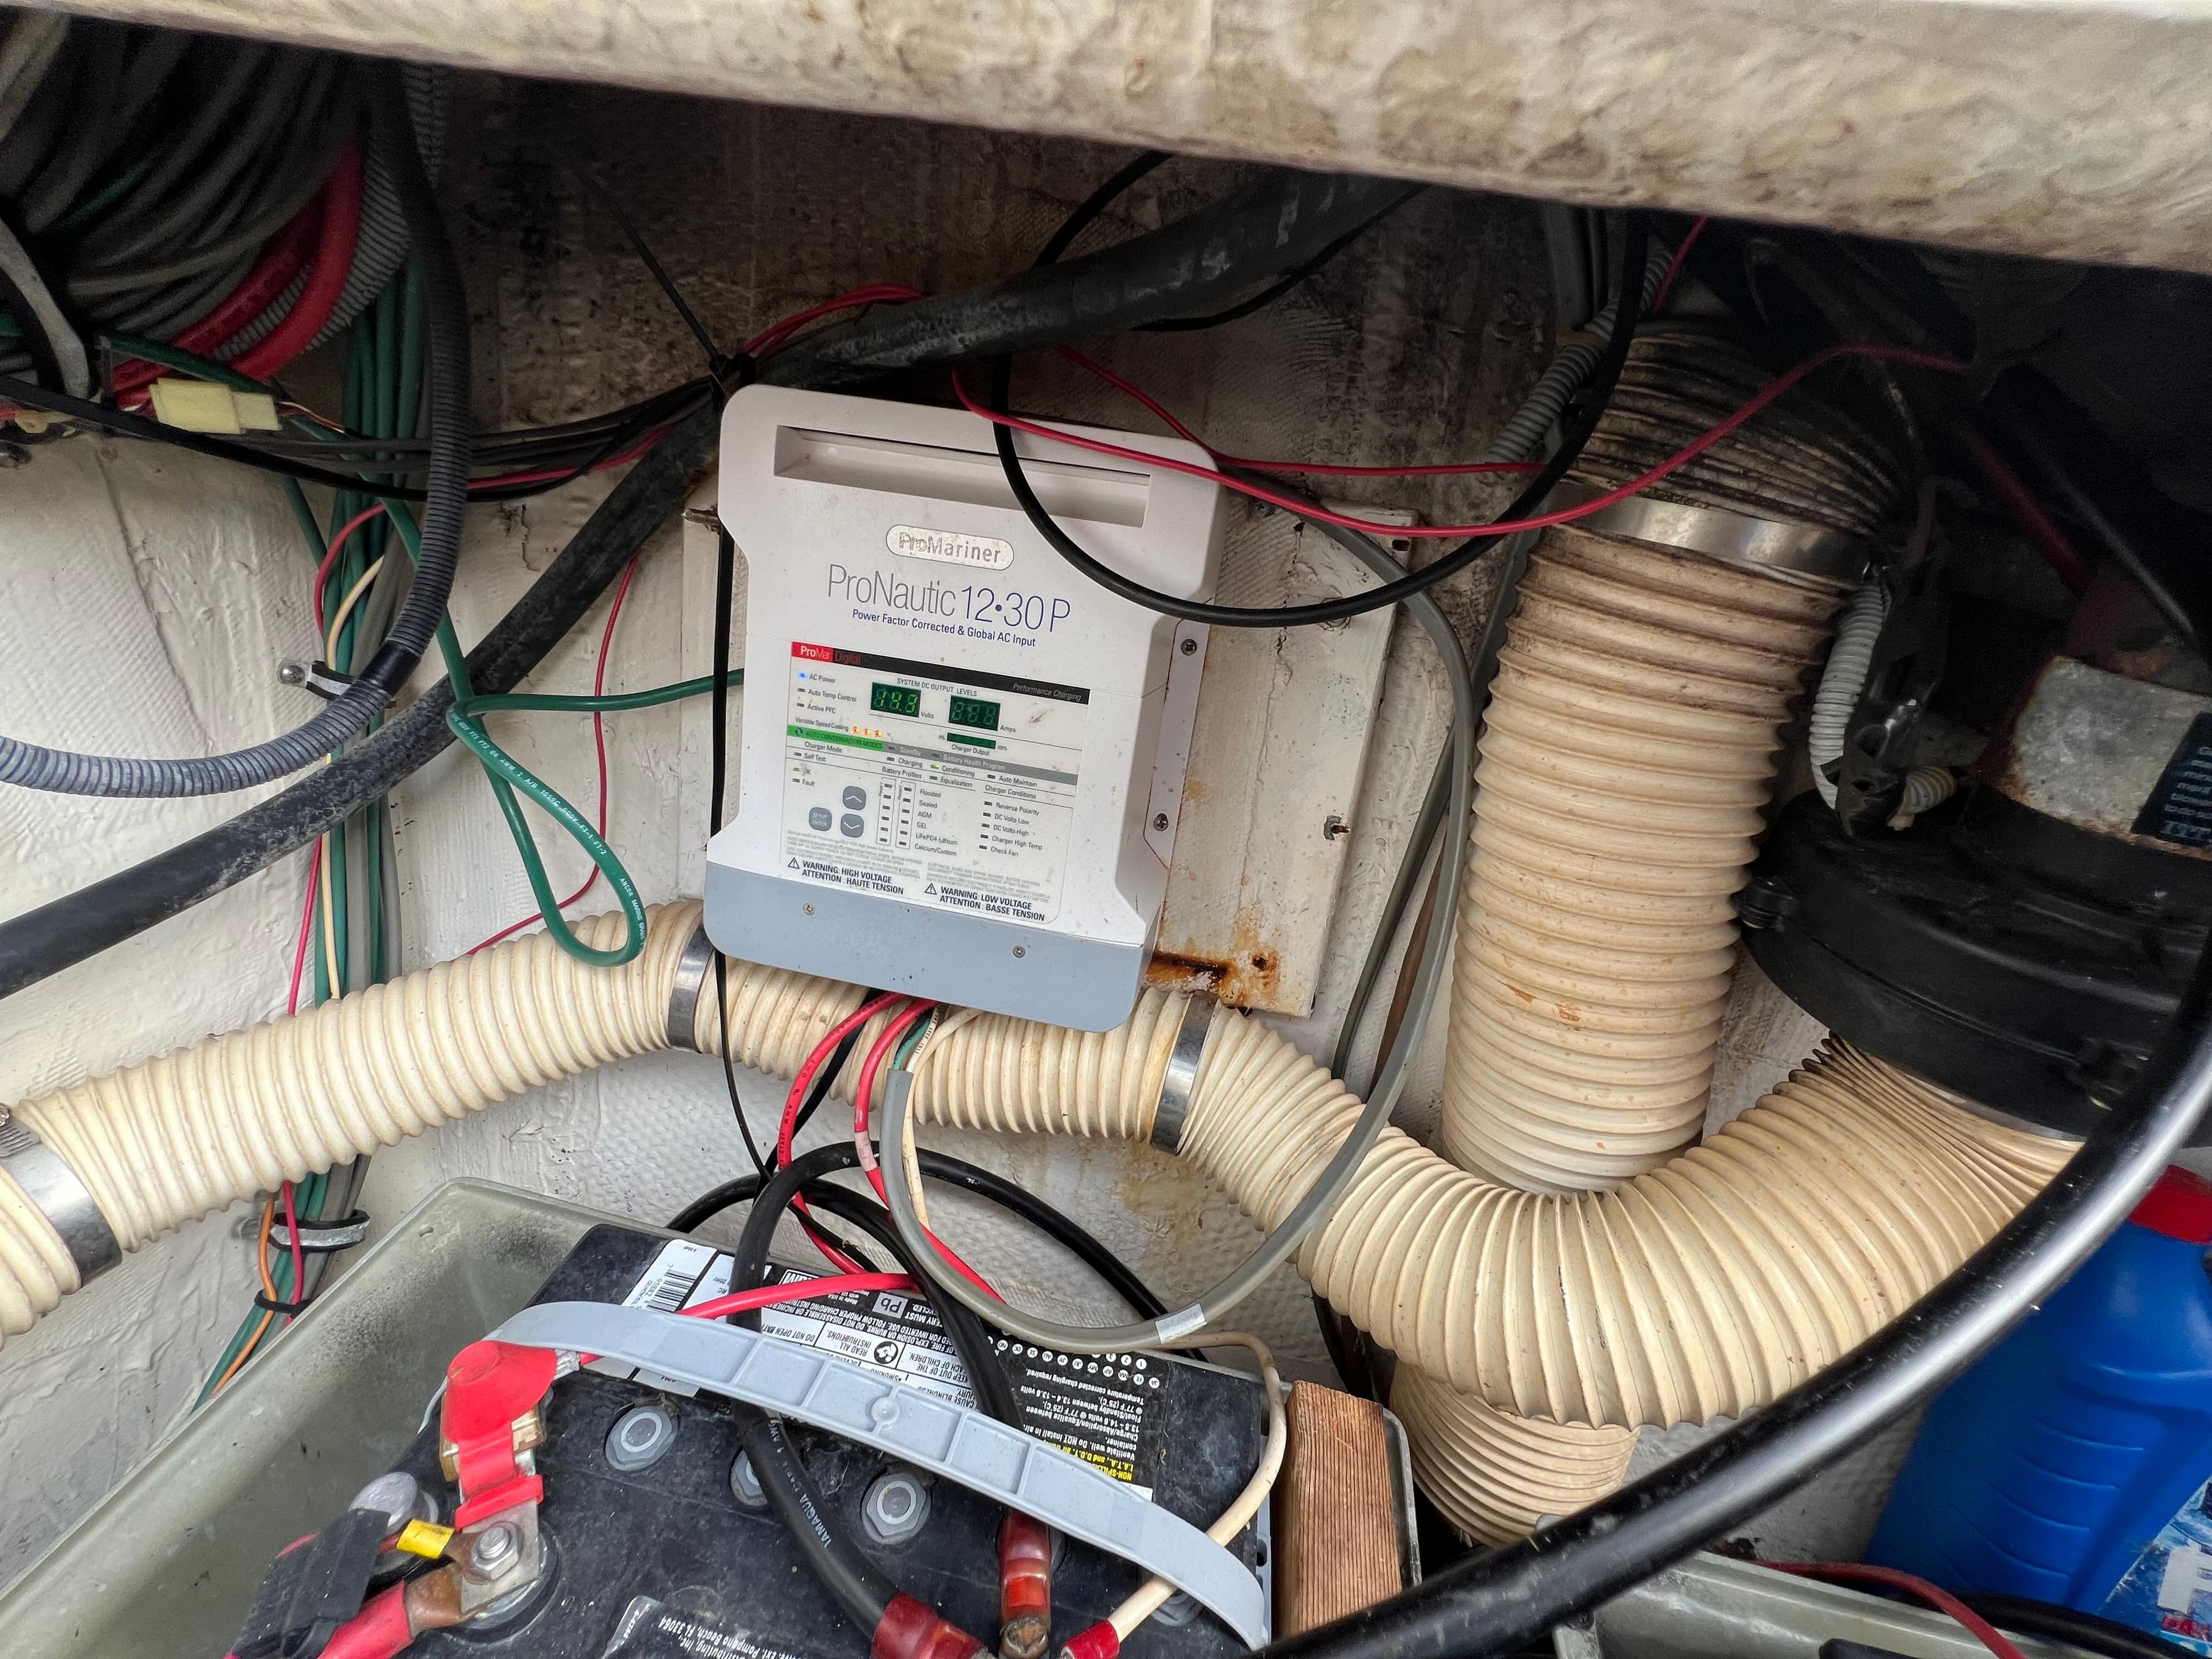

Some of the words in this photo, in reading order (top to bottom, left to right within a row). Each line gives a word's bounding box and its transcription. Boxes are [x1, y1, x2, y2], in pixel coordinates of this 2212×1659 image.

[899, 532, 1001, 563] ProMariner
[828, 564, 956, 616] ProNautic
[853, 609, 880, 623] Power
[882, 614, 908, 626] Factor
[912, 618, 955, 634] Corrected
[958, 626, 964, 635] &
[968, 627, 995, 640] Global
[998, 632, 1010, 642] AC
[1013, 634, 1036, 647] Input
[819, 675, 835, 683] Power
[897, 679, 919, 687] SYSTEM
[931, 683, 954, 692] OUTPUT
[957, 688, 977, 696] LEVELS
[1013, 683, 1051, 696] Performance
[1053, 690, 1081, 701] Charging
[822, 691, 836, 699] Temp
[838, 692, 857, 702] Control
[808, 704, 824, 712] Active
[796, 717, 814, 726] Variable
[816, 720, 831, 729] Speed
[831, 722, 849, 732] Cooling
[1000, 725, 1016, 733] Amps
[821, 733, 862, 746] CONSERVATION
[863, 741, 882, 749] MODES
[805, 741, 826, 752] Charger
[900, 747, 922, 756] Standby
[944, 754, 963, 763] Battery
[982, 761, 1006, 771] Program
[952, 744, 971, 753] Charger
[973, 748, 990, 756] Output
[899, 757, 922, 768] Charging
[942, 766, 975, 777] Conditioning
[1013, 778, 1037, 787] Maintain
[882, 767, 900, 775] Battery
[902, 770, 922, 778] Profiles
[941, 777, 972, 787] Equalization
[985, 785, 1006, 794] Charger
[1008, 789, 1036, 799] Conditions
[921, 789, 941, 798] Flooded
[919, 801, 938, 809] Sealed
[996, 802, 1018, 812] Reverse
[1020, 806, 1040, 816] Polarity
[1002, 826, 1016, 834] Volts
[1017, 829, 1029, 837] High
[915, 843, 957, 856] Calcium/Custom
[992, 836, 1013, 845] Charger
[1014, 839, 1027, 849] High
[1029, 842, 1043, 850] Temp
[991, 846, 1007, 855] Check
[803, 861, 840, 874] WARNING:
[842, 868, 858, 877] HIGH
[861, 872, 892, 884] VOLTAGE
[802, 870, 841, 882] ATTENTION
[847, 877, 870, 888] HAUTE
[872, 882, 903, 894] TENSION
[941, 886, 980, 900] WARNING:
[981, 894, 998, 903] LOW
[1000, 898, 1032, 910] VOLTAGE
[940, 896, 980, 909] ATTENTION
[986, 904, 1009, 915] BASSE
[1013, 909, 1044, 921] TENSION
[809, 1302, 840, 1316] CHARGING
[881, 1298, 902, 1313] Pb
[805, 1309, 842, 1325] DISASSEMBLE
[840, 1309, 862, 1321] PROPER
[861, 1315, 887, 1328] FOLLOW
[904, 1311, 926, 1323] MUST
[841, 1319, 855, 1328] NOT
[888, 1322, 900, 1331] USE.
[775, 1328, 792, 1337] OPEN
[792, 1332, 805, 1340] NOT
[866, 1325, 887, 1336] BURNS.
[900, 1325, 929, 1339] INVERTED
[898, 1334, 929, 1347] EXPLOSION
[929, 1333, 941, 1343] FOR
[839, 1342, 851, 1351] ALL
[852, 1346, 868, 1357] READ
[909, 1352, 941, 1367] CHILDREN.
[941, 1361, 950, 1369] OF
[916, 1363, 928, 1373] THE
[940, 1370, 952, 1378] OUT
[1025, 1369, 1052, 1380] required.
[1052, 1374, 1078, 1389] charging
[1020, 1385, 1035, 1394] volts
[1078, 1382, 1105, 1396] corrected
[1107, 1389, 1144, 1406] Temperature
[1072, 1399, 1098, 1412] between
[1026, 1406, 1052, 1420] between
[1088, 1413, 1103, 1423] volts
[1099, 1407, 1141, 1423] Float/Standby
[1042, 1429, 1063, 1442] install
[1064, 1434, 1078, 1446] NOT
[1078, 1439, 1088, 1448] Do
[1090, 1442, 1105, 1452] well.
[1105, 1437, 1137, 1451] container.
[1073, 1449, 1092, 1460] D.O.T.
[1093, 1455, 1105, 1463] and
[1107, 1446, 1135, 1461] Ventilate
[658, 1616, 686, 1634] 33064
[697, 1626, 723, 1646] Beach,
[722, 1637, 760, 1658] Pompano
